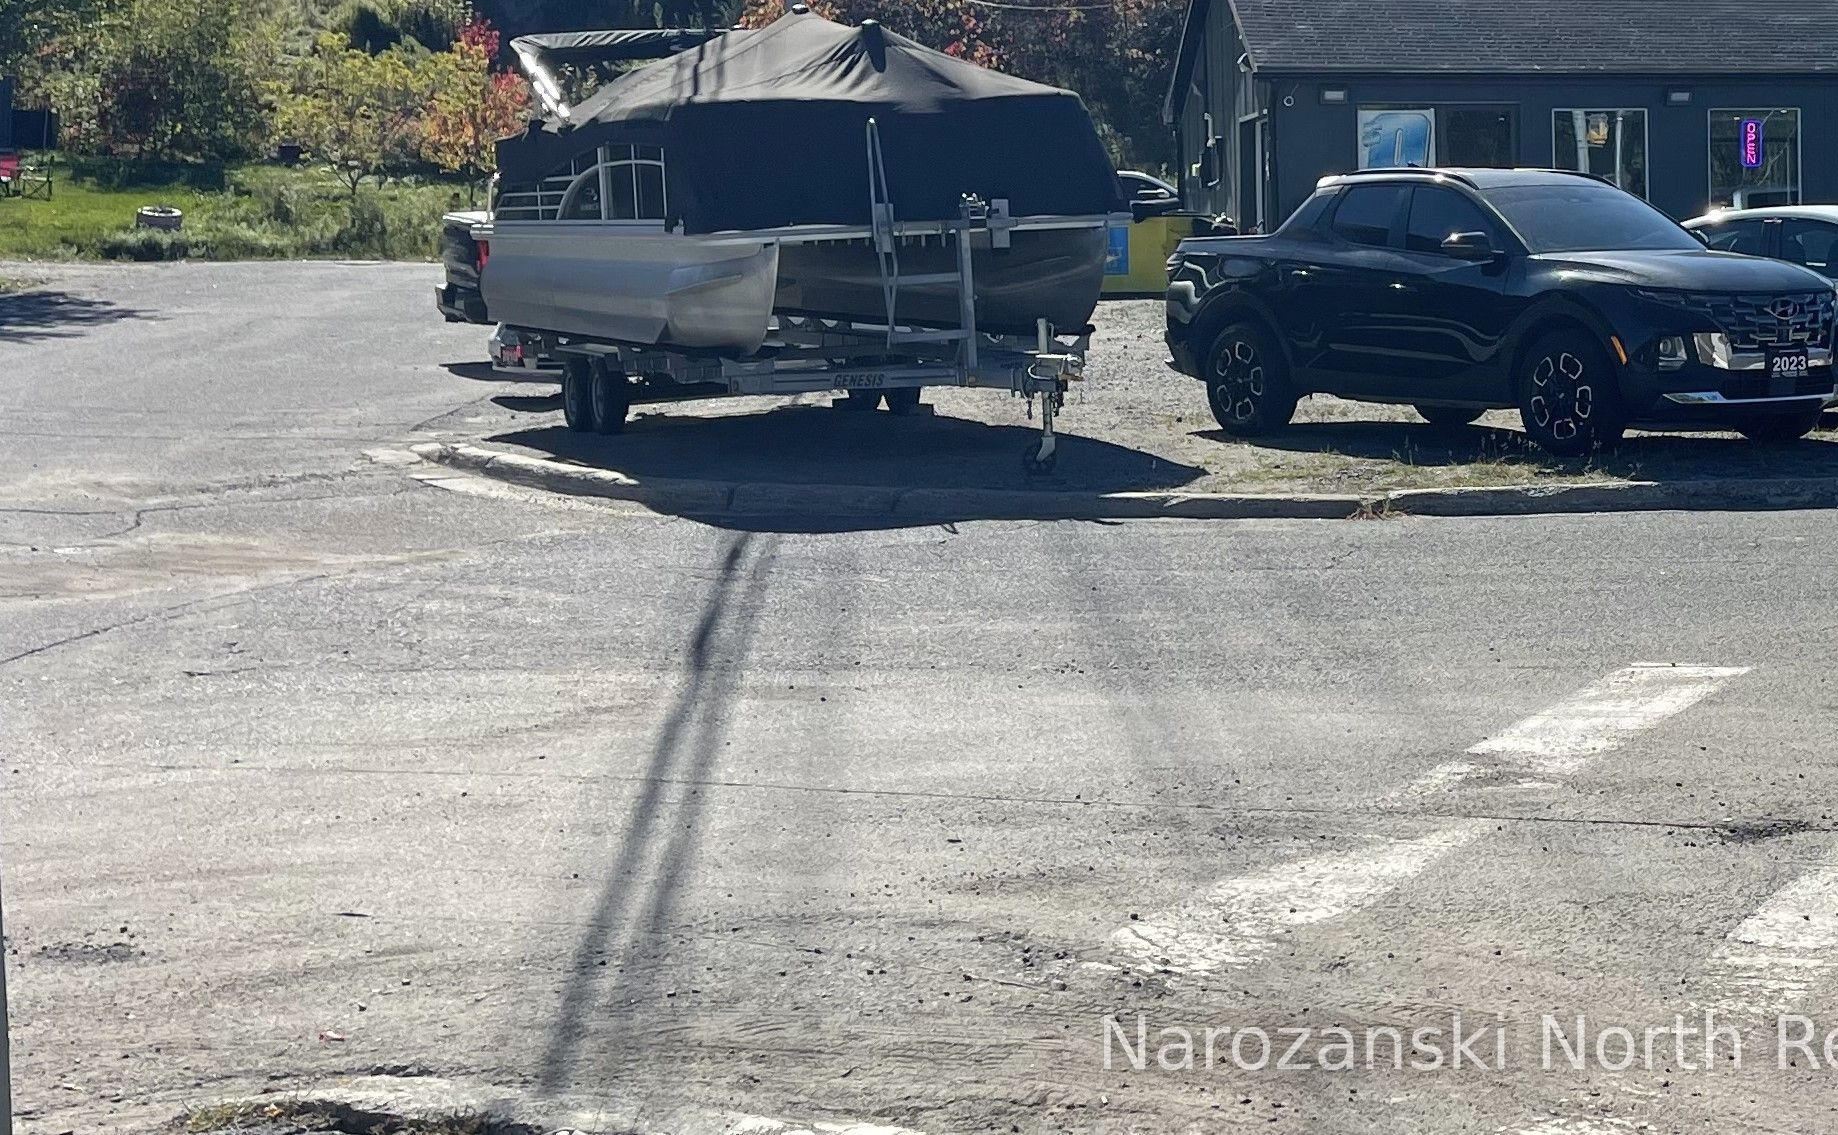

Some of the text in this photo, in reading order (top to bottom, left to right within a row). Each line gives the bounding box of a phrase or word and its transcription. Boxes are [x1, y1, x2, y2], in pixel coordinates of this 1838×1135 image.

[1747, 122, 1756, 164] OPEN
[1772, 355, 1807, 372] 2023
[833, 374, 885, 387] GENESIS
